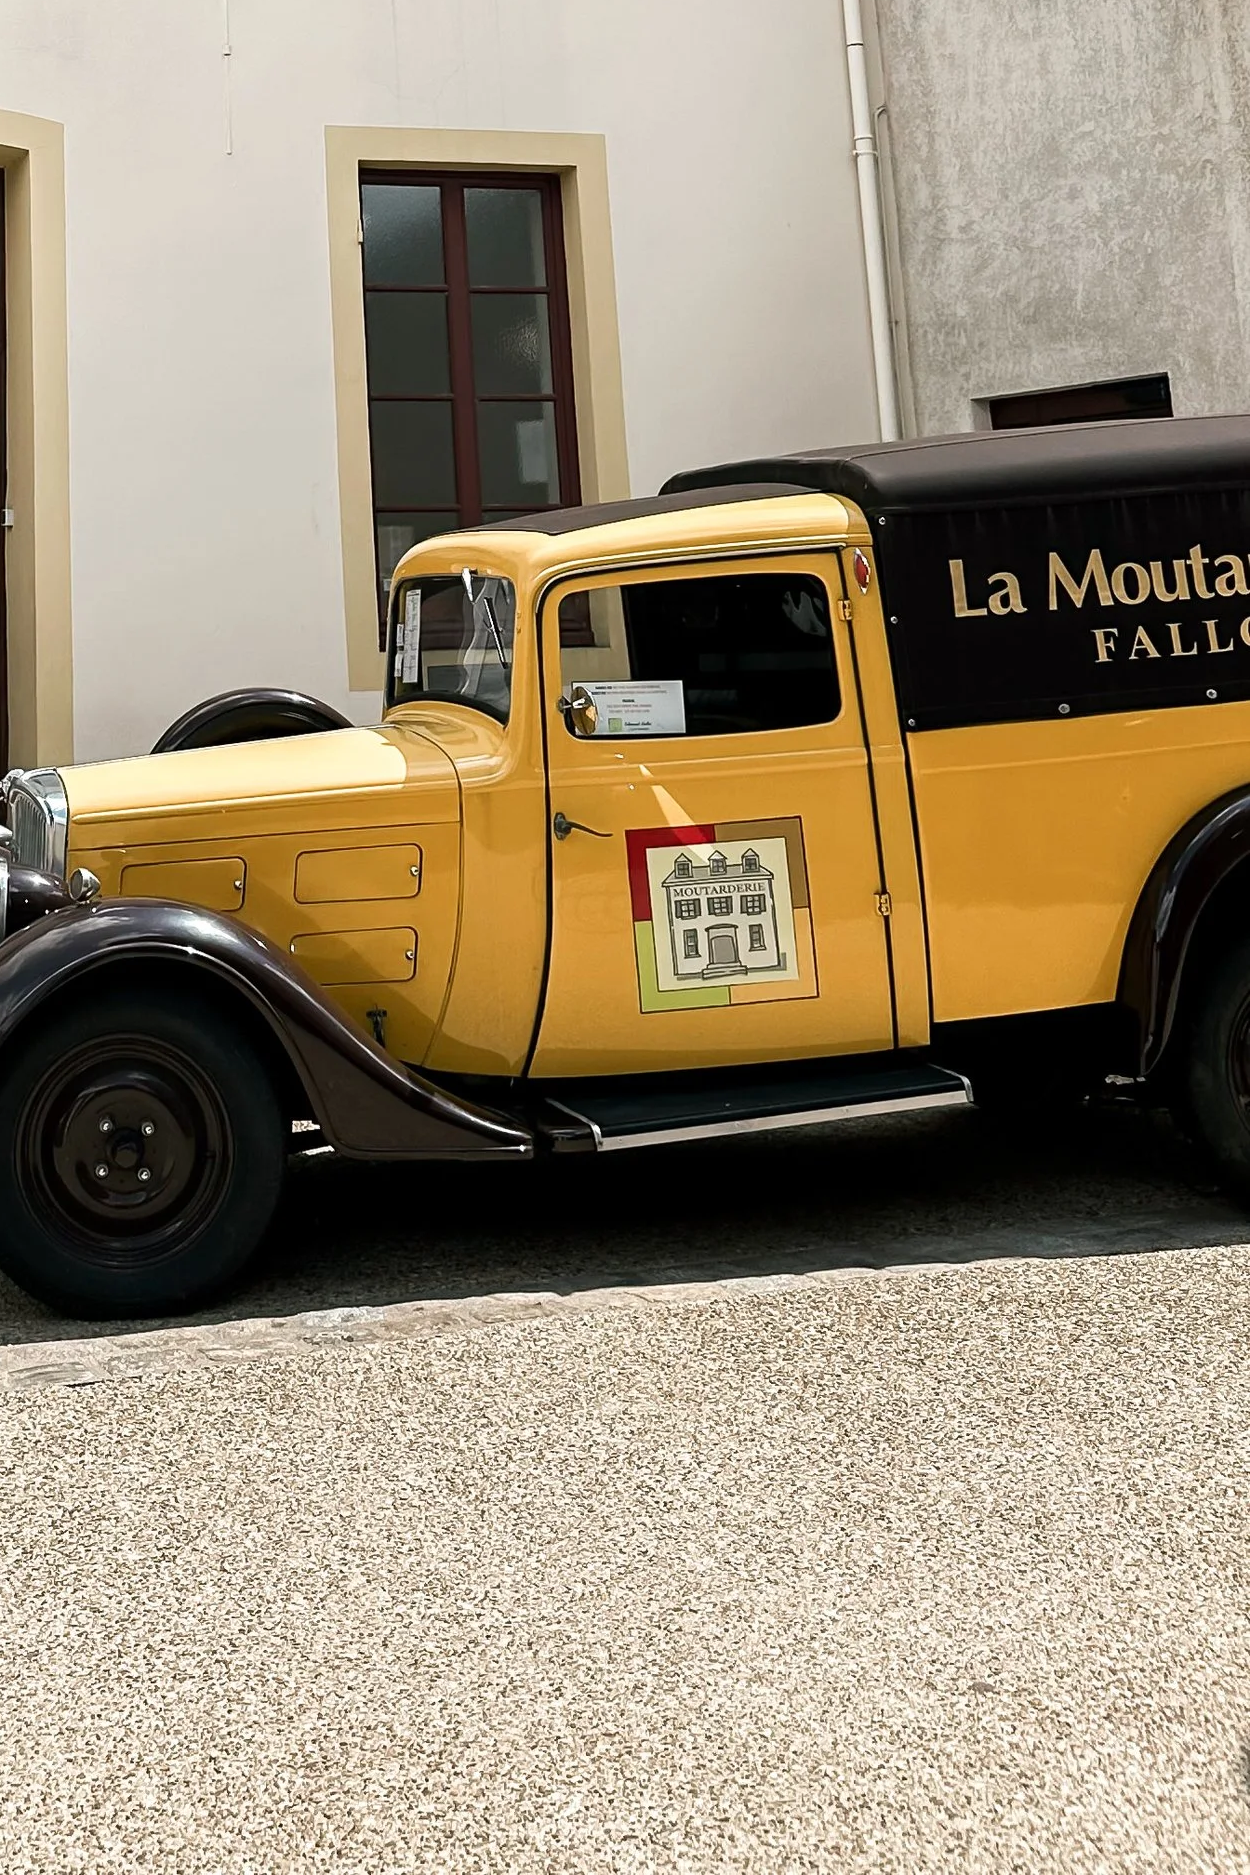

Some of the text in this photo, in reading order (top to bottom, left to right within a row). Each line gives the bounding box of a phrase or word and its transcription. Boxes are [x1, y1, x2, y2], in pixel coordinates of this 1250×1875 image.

[948, 543, 1250, 618] La Mouta
[673, 882, 766, 898] MOUTARDERIE
